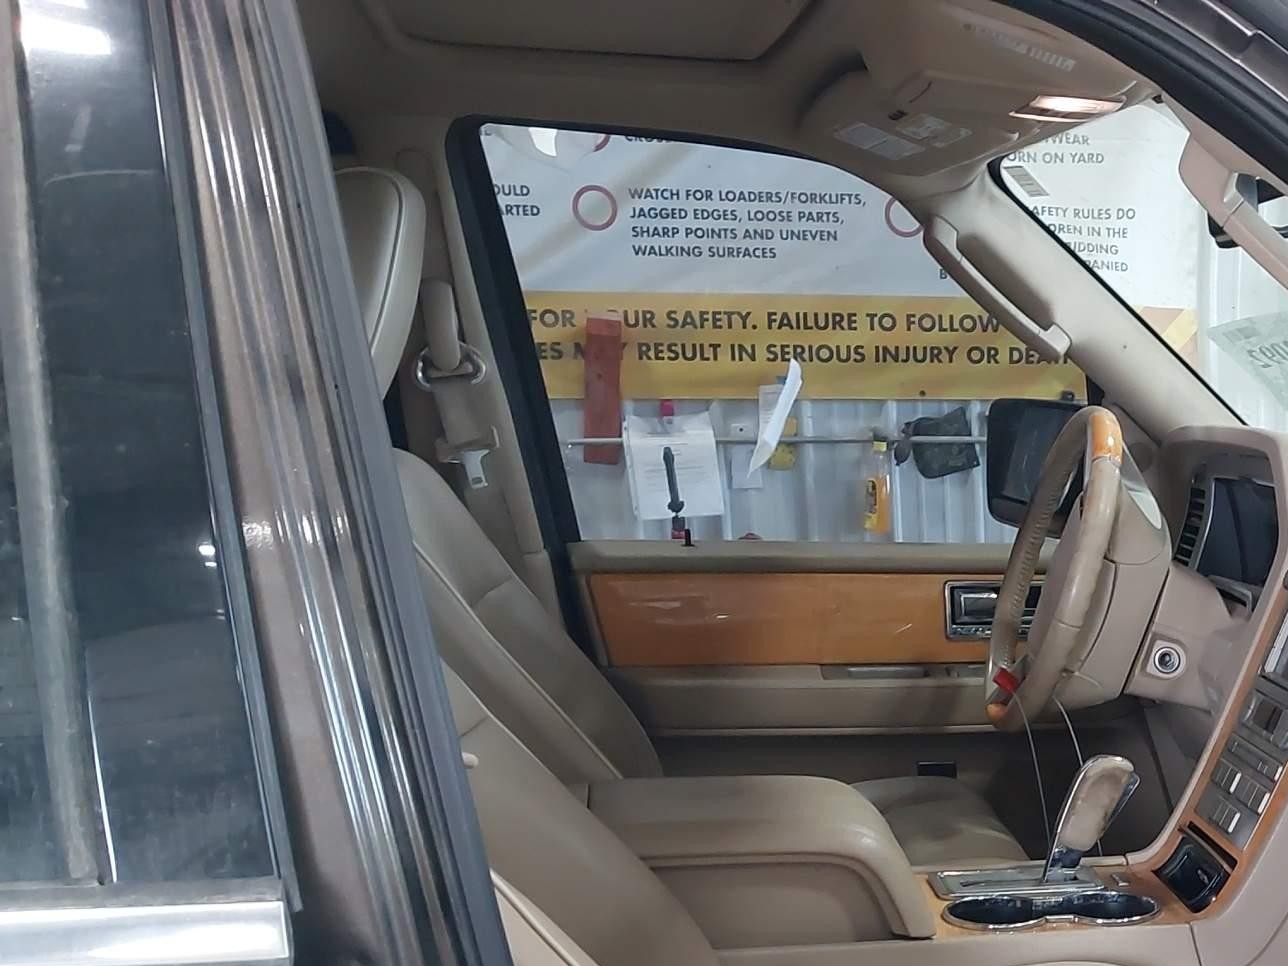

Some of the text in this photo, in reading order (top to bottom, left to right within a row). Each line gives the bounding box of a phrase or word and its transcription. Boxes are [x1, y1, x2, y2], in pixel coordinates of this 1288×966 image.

[1045, 132, 1090, 145] WEAR
[1042, 152, 1064, 164] ON
[1070, 152, 1105, 164] YARD
[628, 188, 867, 207] WATCH FOR LOADERS/FORKLIFTS,
[630, 207, 845, 225] JAGGED EDGES, LOOSE PARTS,
[1073, 208, 1112, 220] RULES
[1116, 208, 1136, 220] DO
[631, 226, 838, 242] SHARP POINTS AND UNEVEN
[1087, 226, 1102, 237] IN
[1106, 227, 1128, 238] THE
[632, 244, 777, 259] WALKING SURFACES
[1066, 241, 1119, 256] IDDING
[527, 308, 577, 329] FOR
[666, 309, 758, 330] SAFETY.
[767, 310, 858, 331] FAILURE
[866, 312, 897, 332] TO
[906, 313, 1000, 333] FOLLOW
[638, 342, 722, 361] RESULT
[731, 343, 756, 362] IN
[766, 344, 866, 363] SERIOUS
[875, 345, 957, 364] INJURY
[966, 346, 1000, 365] OR
